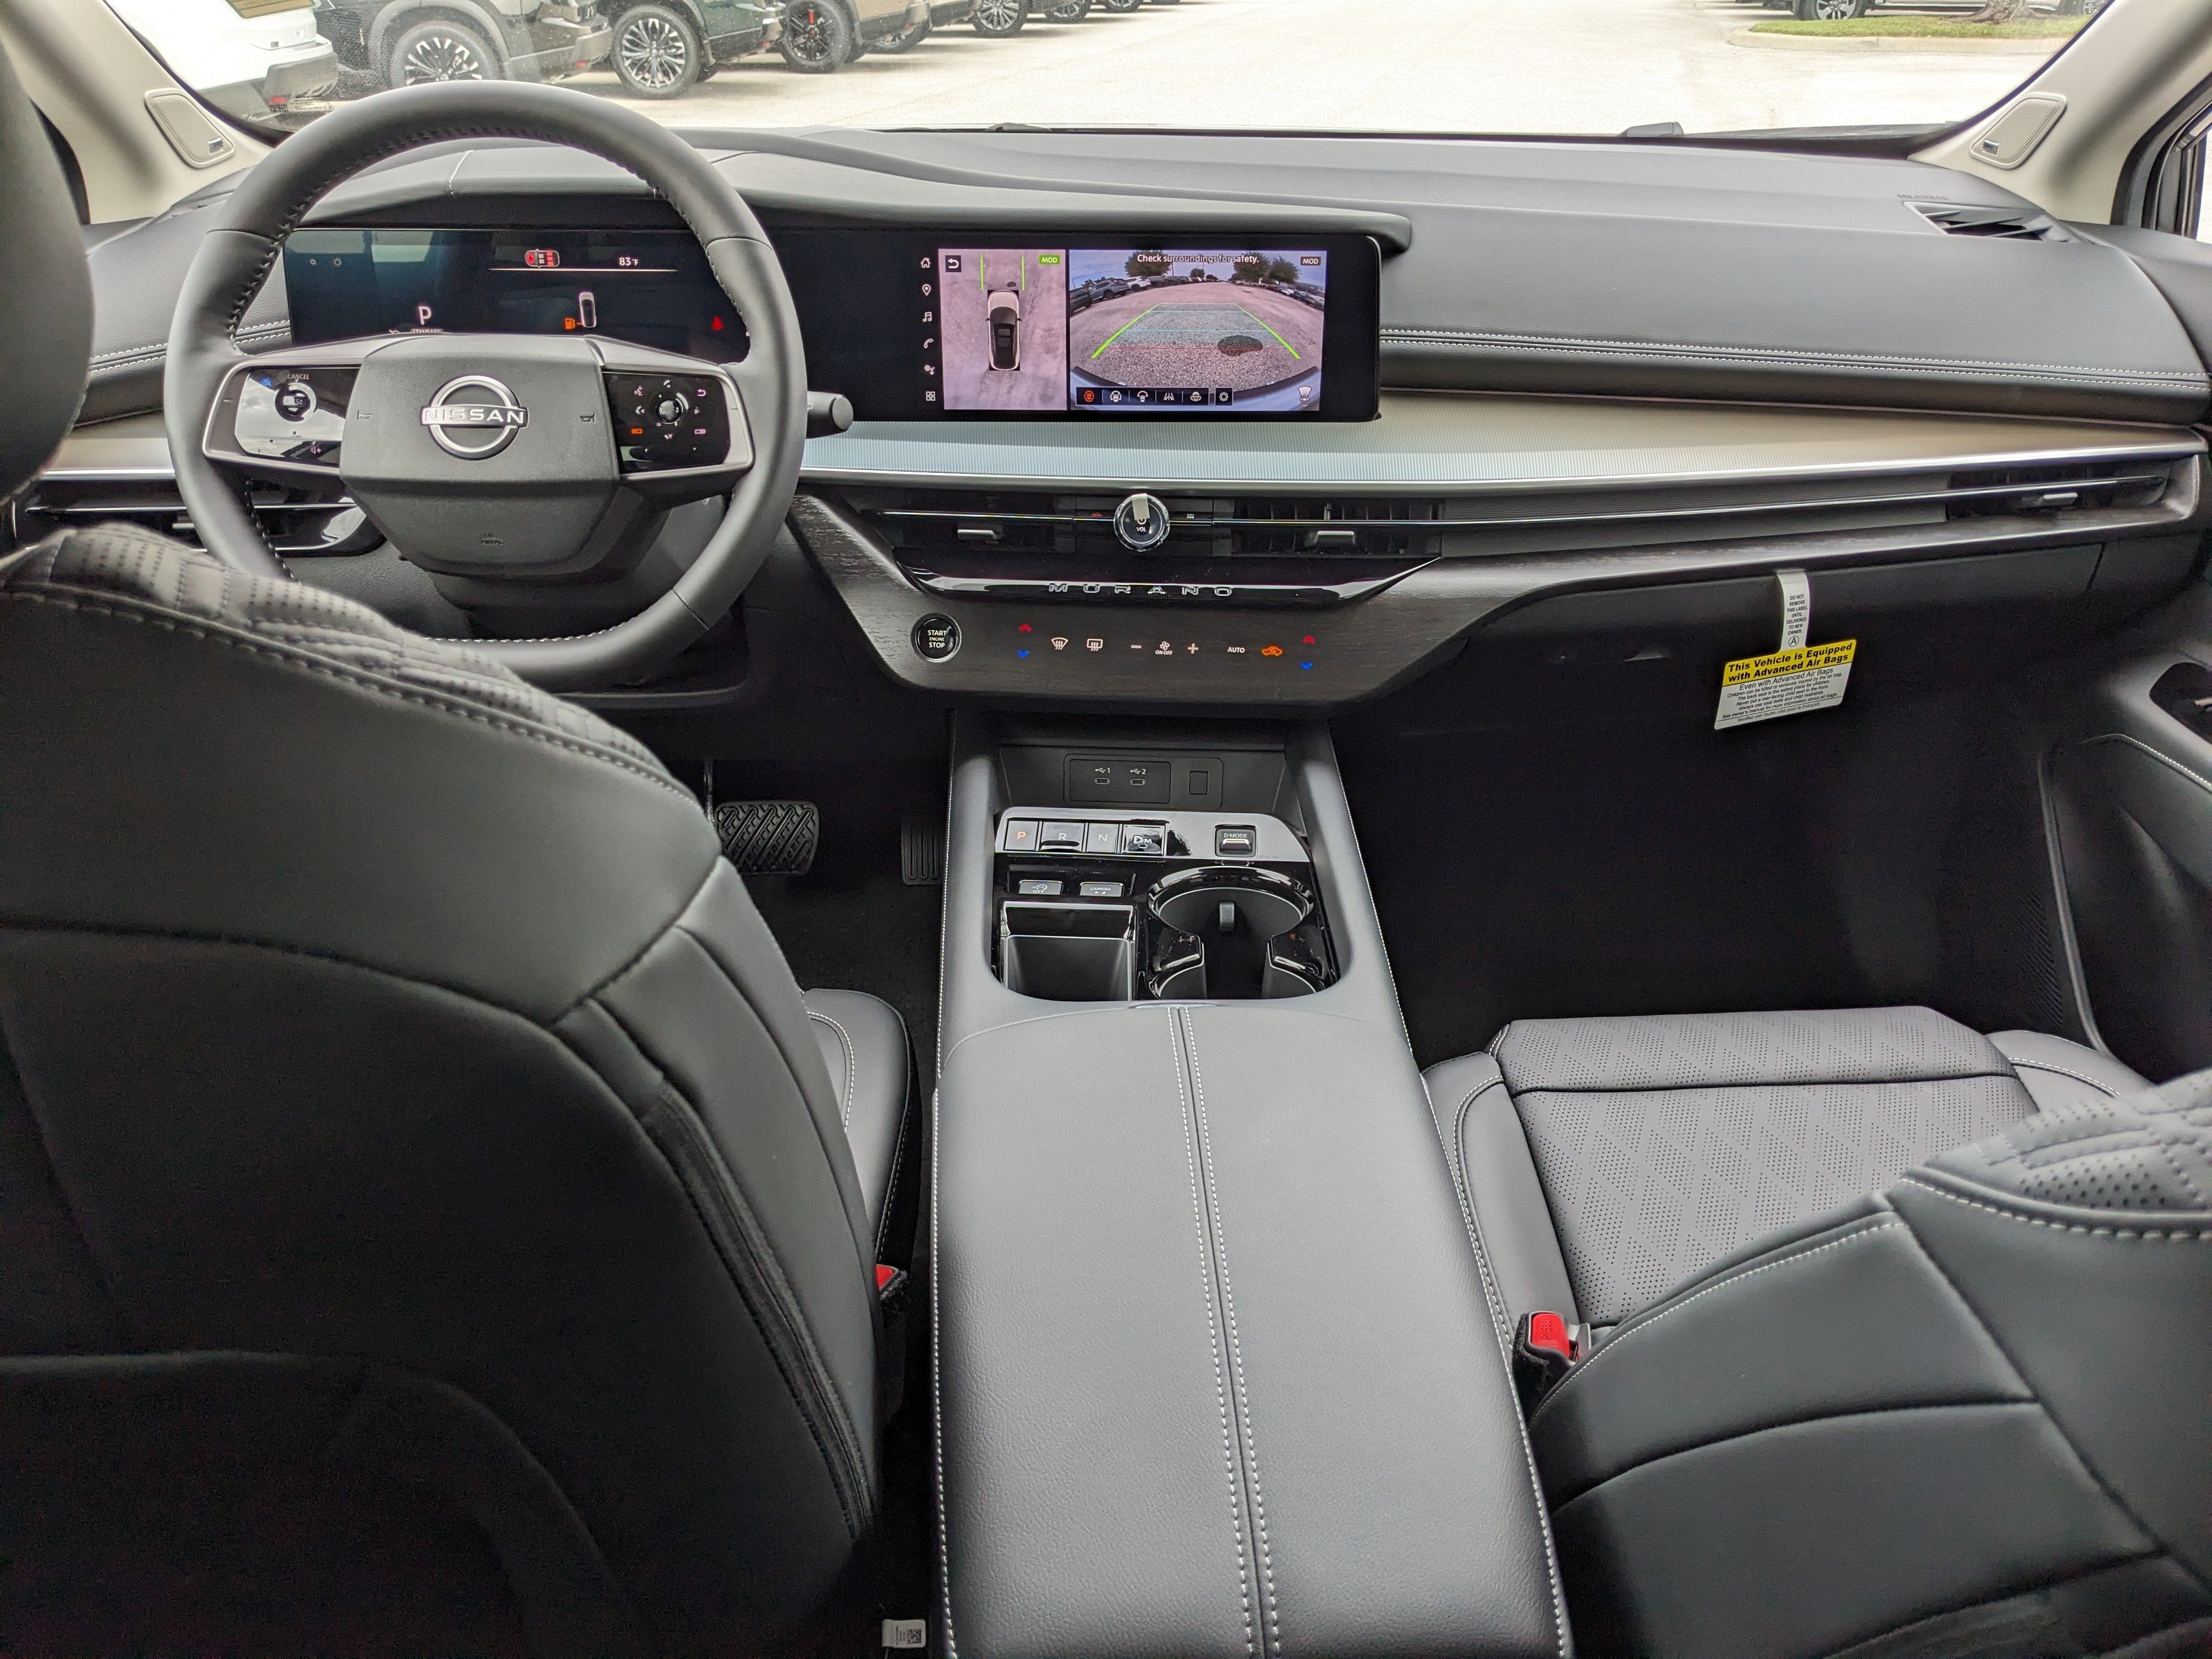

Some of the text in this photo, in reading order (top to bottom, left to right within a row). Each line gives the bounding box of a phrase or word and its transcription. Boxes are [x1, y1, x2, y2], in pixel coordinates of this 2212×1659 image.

[1137, 254, 1259, 264] Check surroundings for safety.
[419, 306, 432, 325] P
[425, 408, 524, 424] NISSAN
[1048, 583, 1233, 597] MURANO
[1729, 642, 1853, 673] This Vehicle is Equipped
[1728, 654, 1849, 682] with Advanced Air Bags
[1773, 673, 1805, 684] Advanced
[1762, 693, 1784, 702] rear-facing
[1017, 831, 1027, 839] P
[1058, 833, 1067, 841] R
[1098, 834, 1108, 842] N
